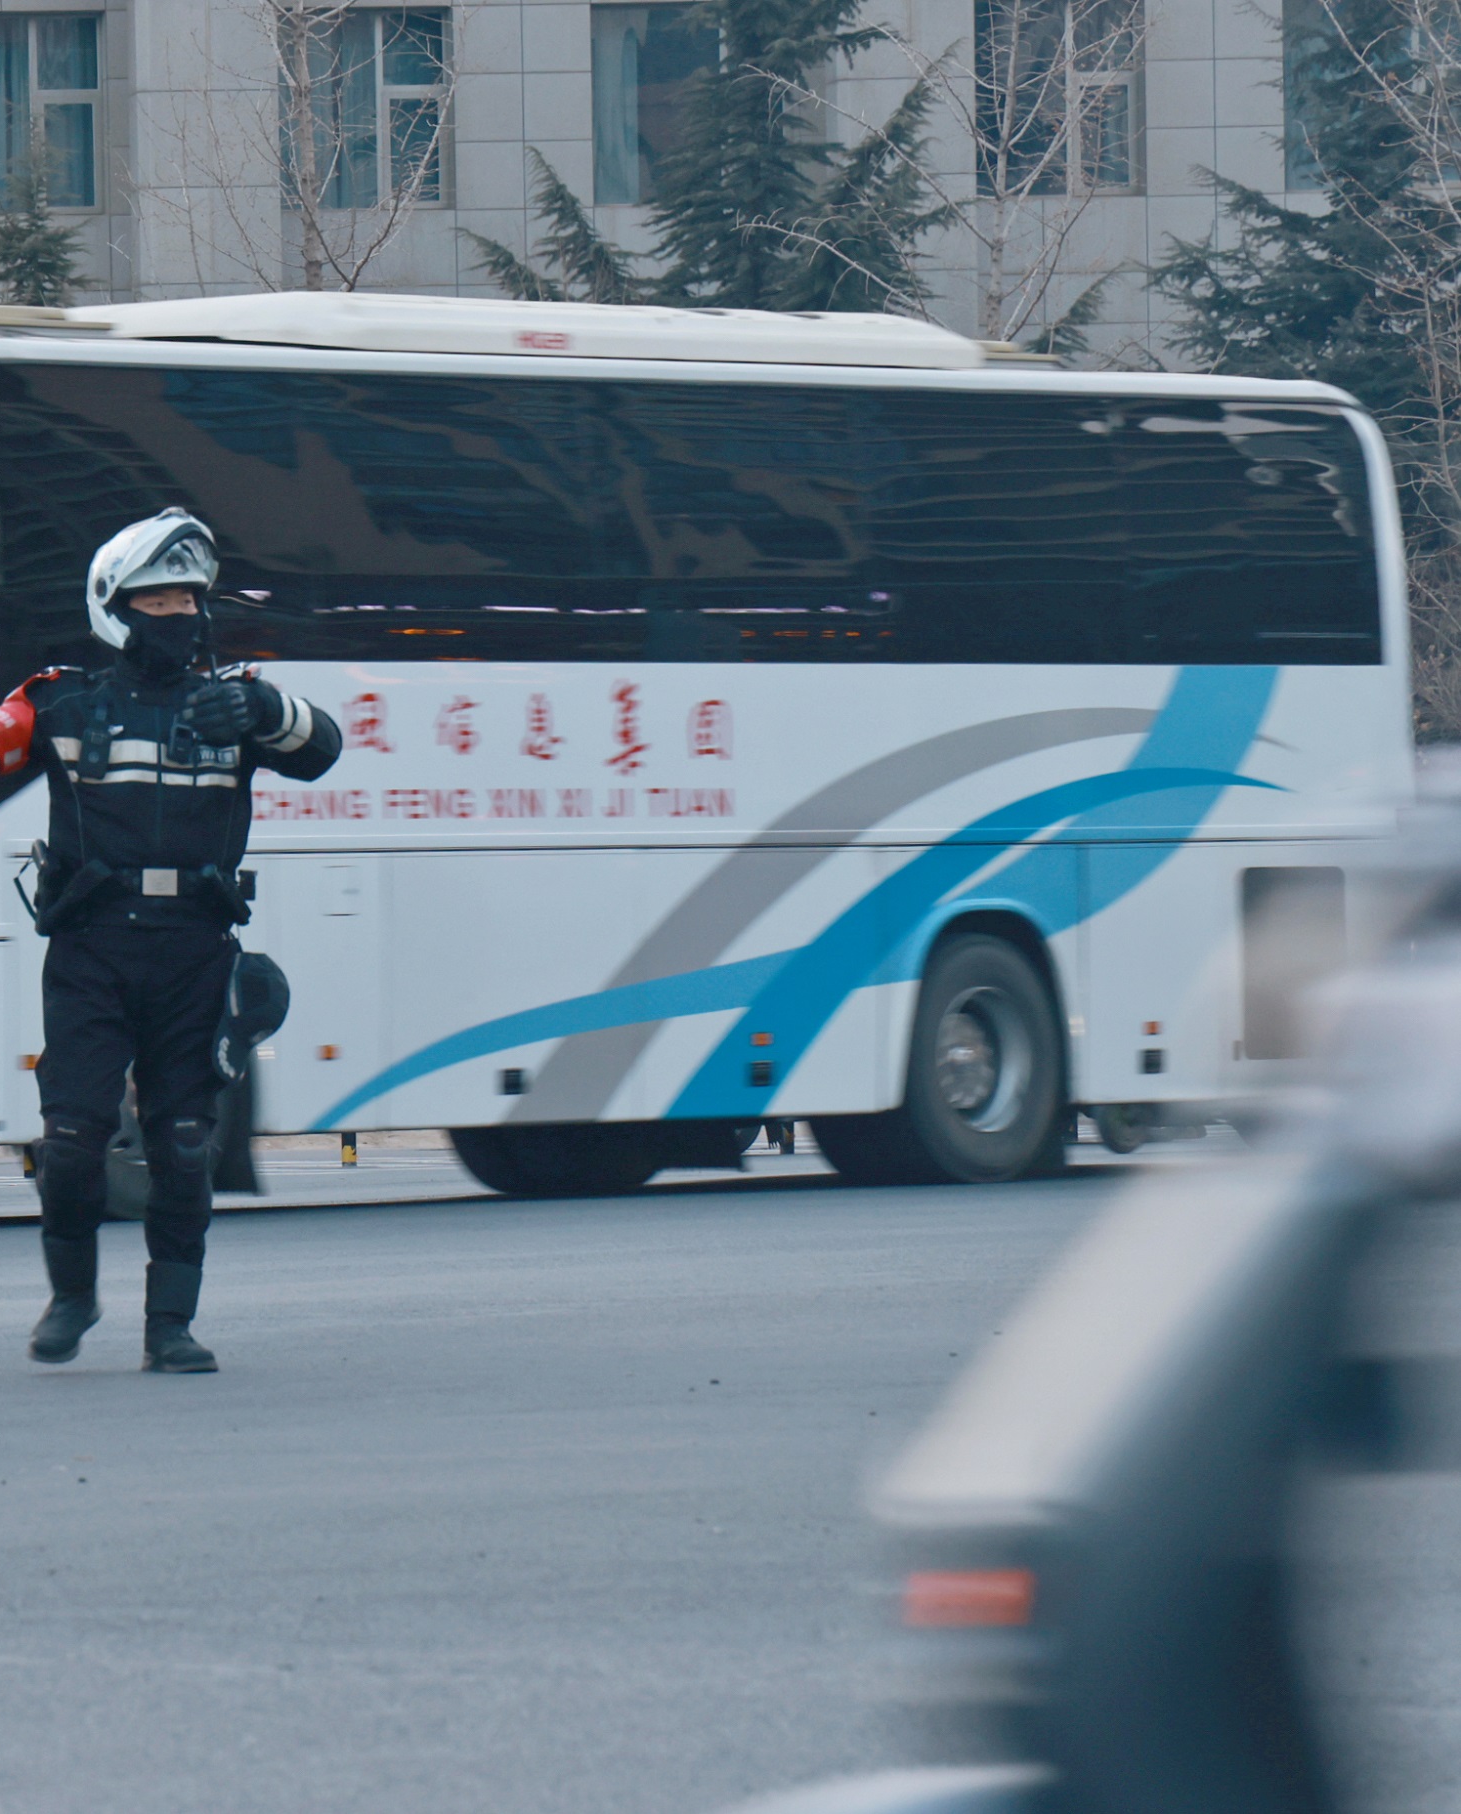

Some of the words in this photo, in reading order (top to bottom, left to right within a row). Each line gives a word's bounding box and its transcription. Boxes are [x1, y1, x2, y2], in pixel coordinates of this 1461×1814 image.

[251, 789, 372, 820] CHANG
[382, 789, 477, 819] FENG
[486, 788, 548, 818] XIN
[601, 788, 636, 818] JI
[643, 787, 737, 817] TUAN
